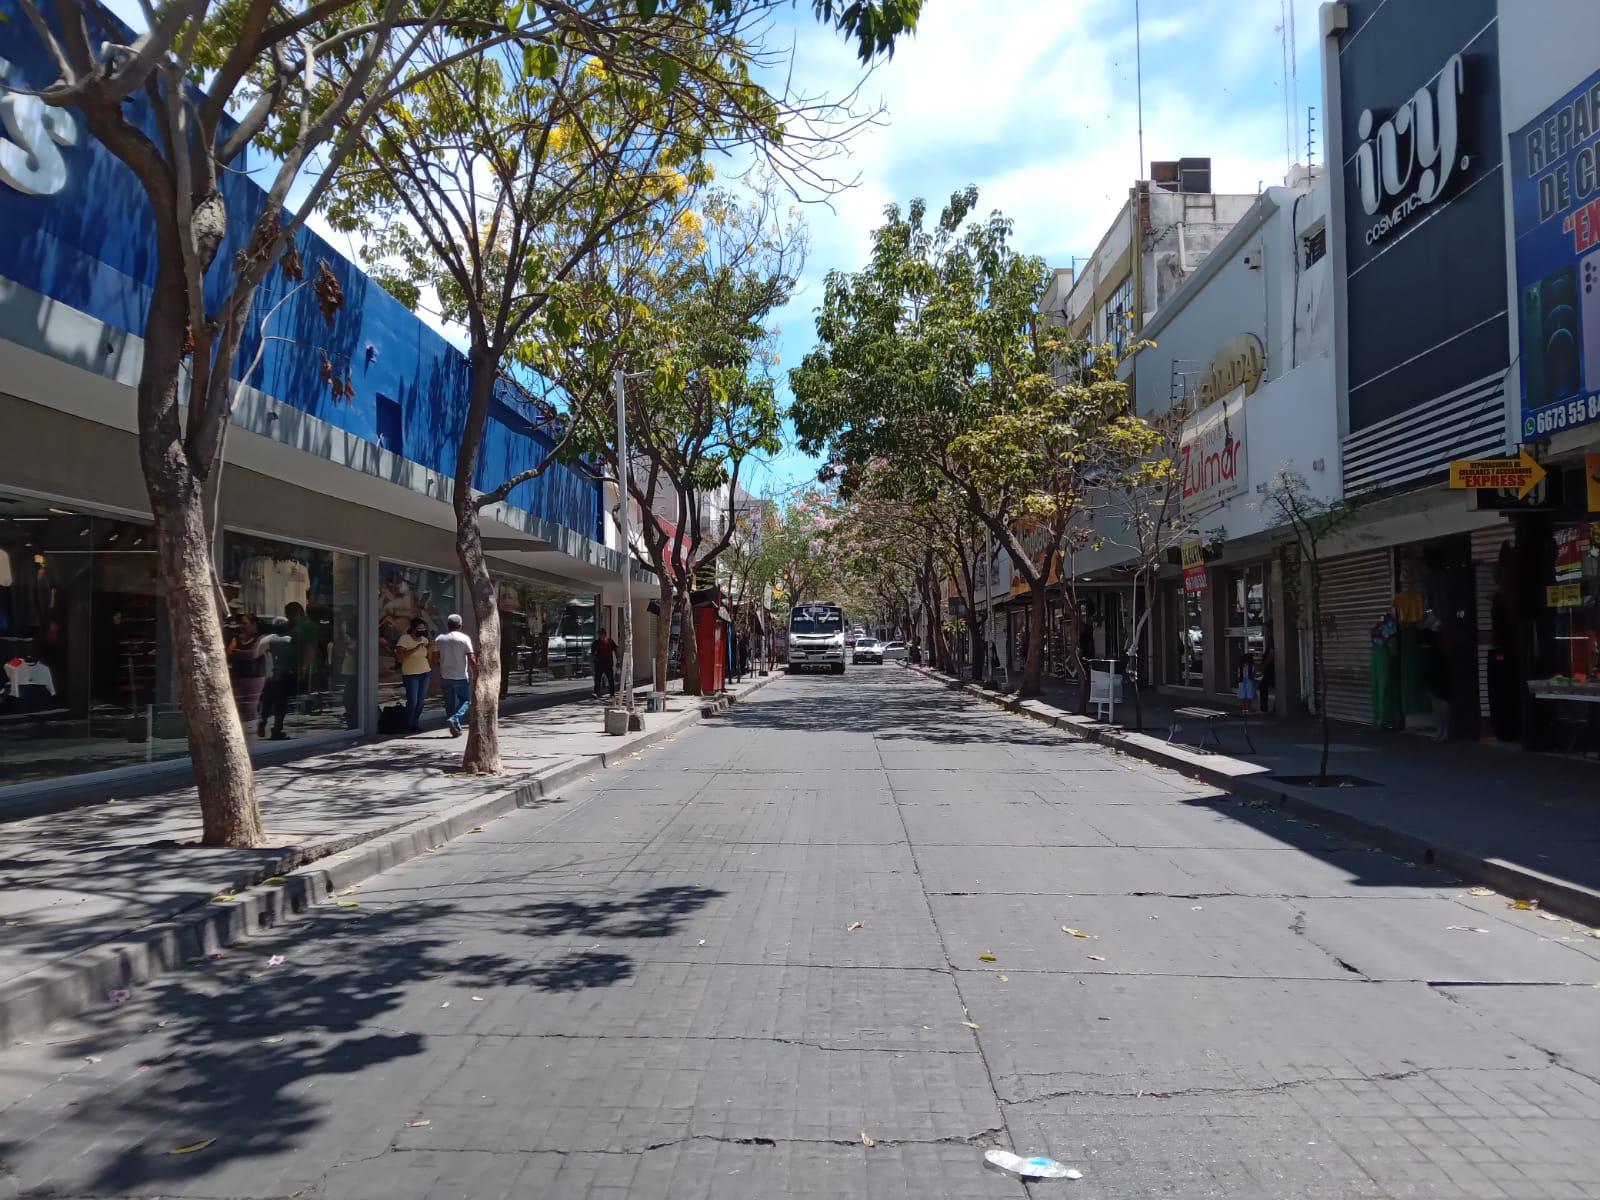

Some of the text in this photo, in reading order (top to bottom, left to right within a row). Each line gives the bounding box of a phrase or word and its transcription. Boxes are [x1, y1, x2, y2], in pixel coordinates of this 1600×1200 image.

[1538, 161, 1571, 224] DE
[1537, 405, 1566, 434] 6673
[1568, 399, 1586, 424] 55
[1181, 439, 1241, 499] Zulmar
